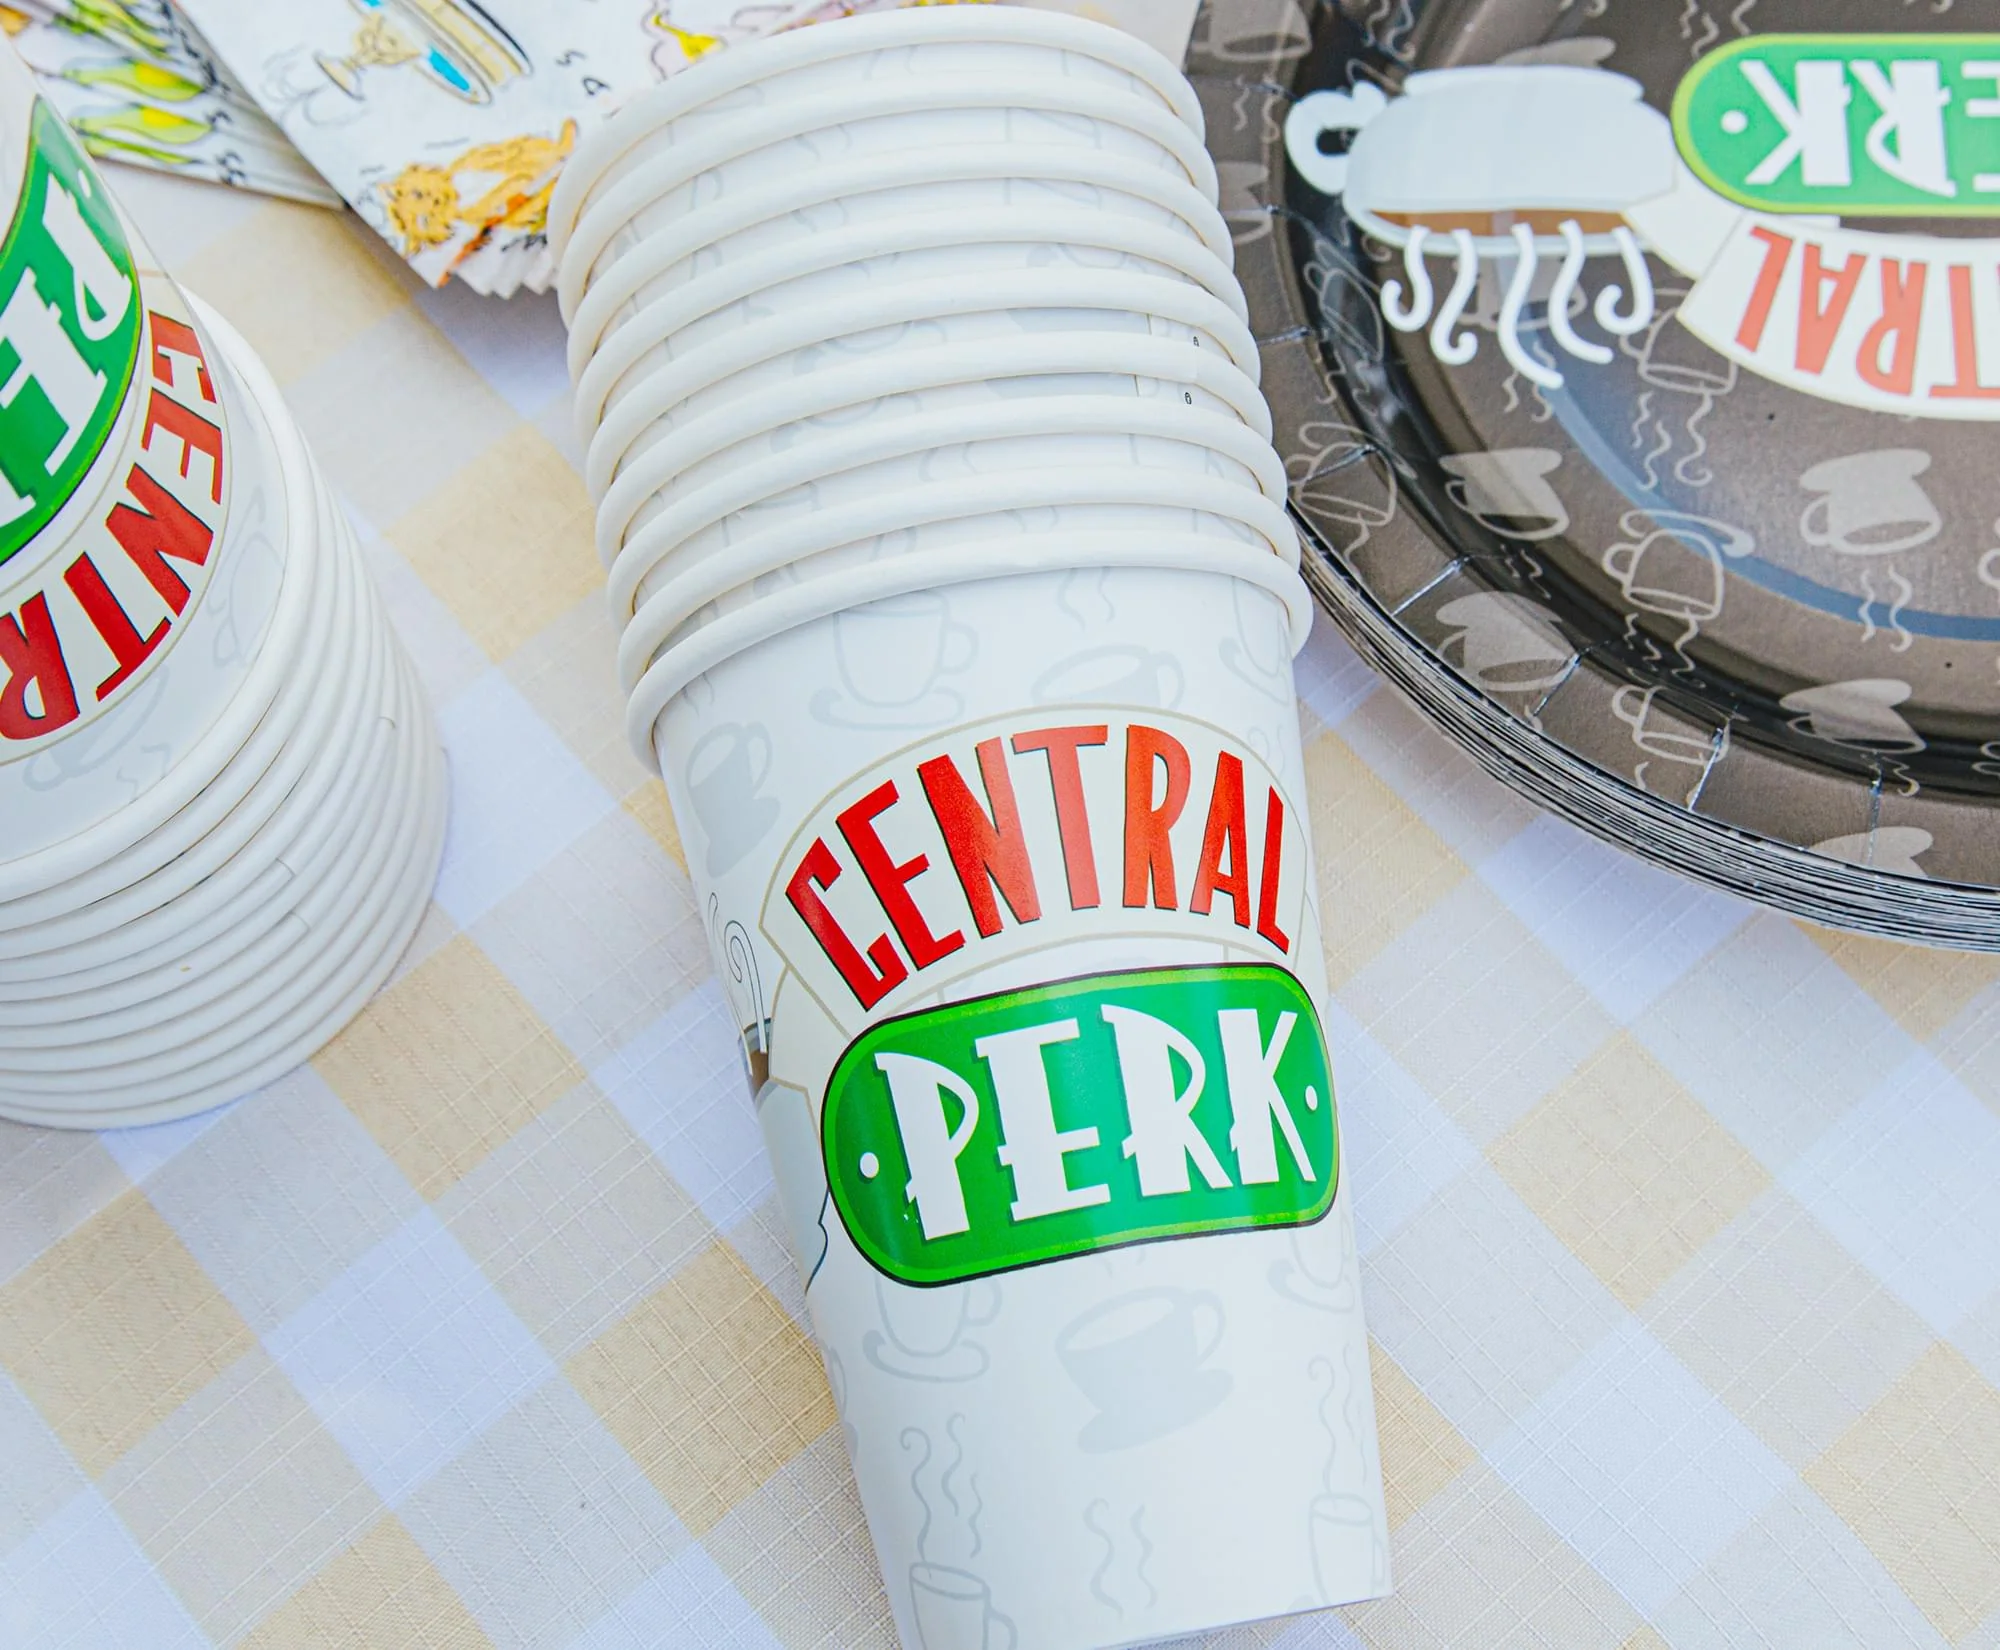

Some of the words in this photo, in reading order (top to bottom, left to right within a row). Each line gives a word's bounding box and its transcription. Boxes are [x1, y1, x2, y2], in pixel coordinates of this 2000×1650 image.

[1735, 224, 2000, 399] TRAL
[785, 724, 1291, 1012] CENTRAL
[874, 1003, 1317, 1241] PERK
